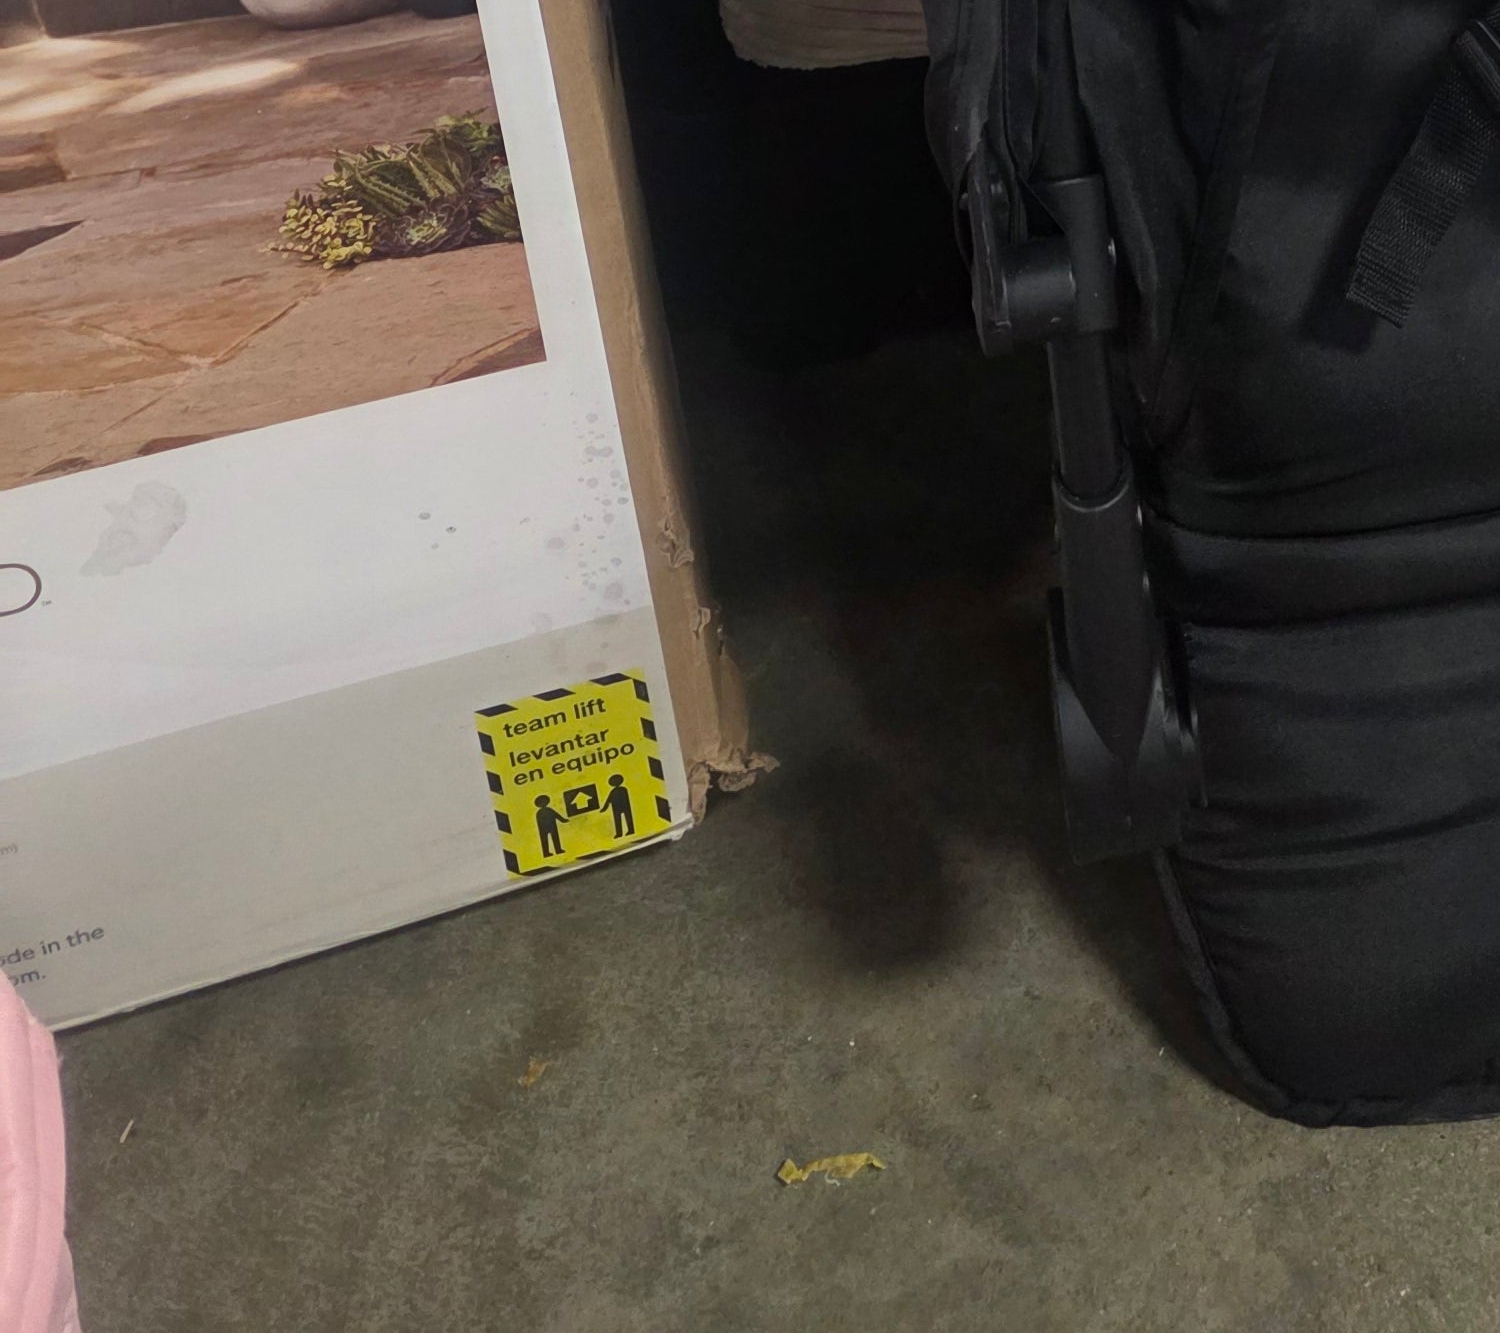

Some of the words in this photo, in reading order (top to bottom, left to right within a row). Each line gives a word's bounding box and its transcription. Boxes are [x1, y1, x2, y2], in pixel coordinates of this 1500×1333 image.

[503, 711, 567, 738] team
[574, 698, 606, 719] lift
[509, 729, 609, 767] levantar
[513, 767, 544, 785] en
[551, 742, 635, 775] equipo
[40, 941, 60, 955] in
[66, 926, 105, 948] the
